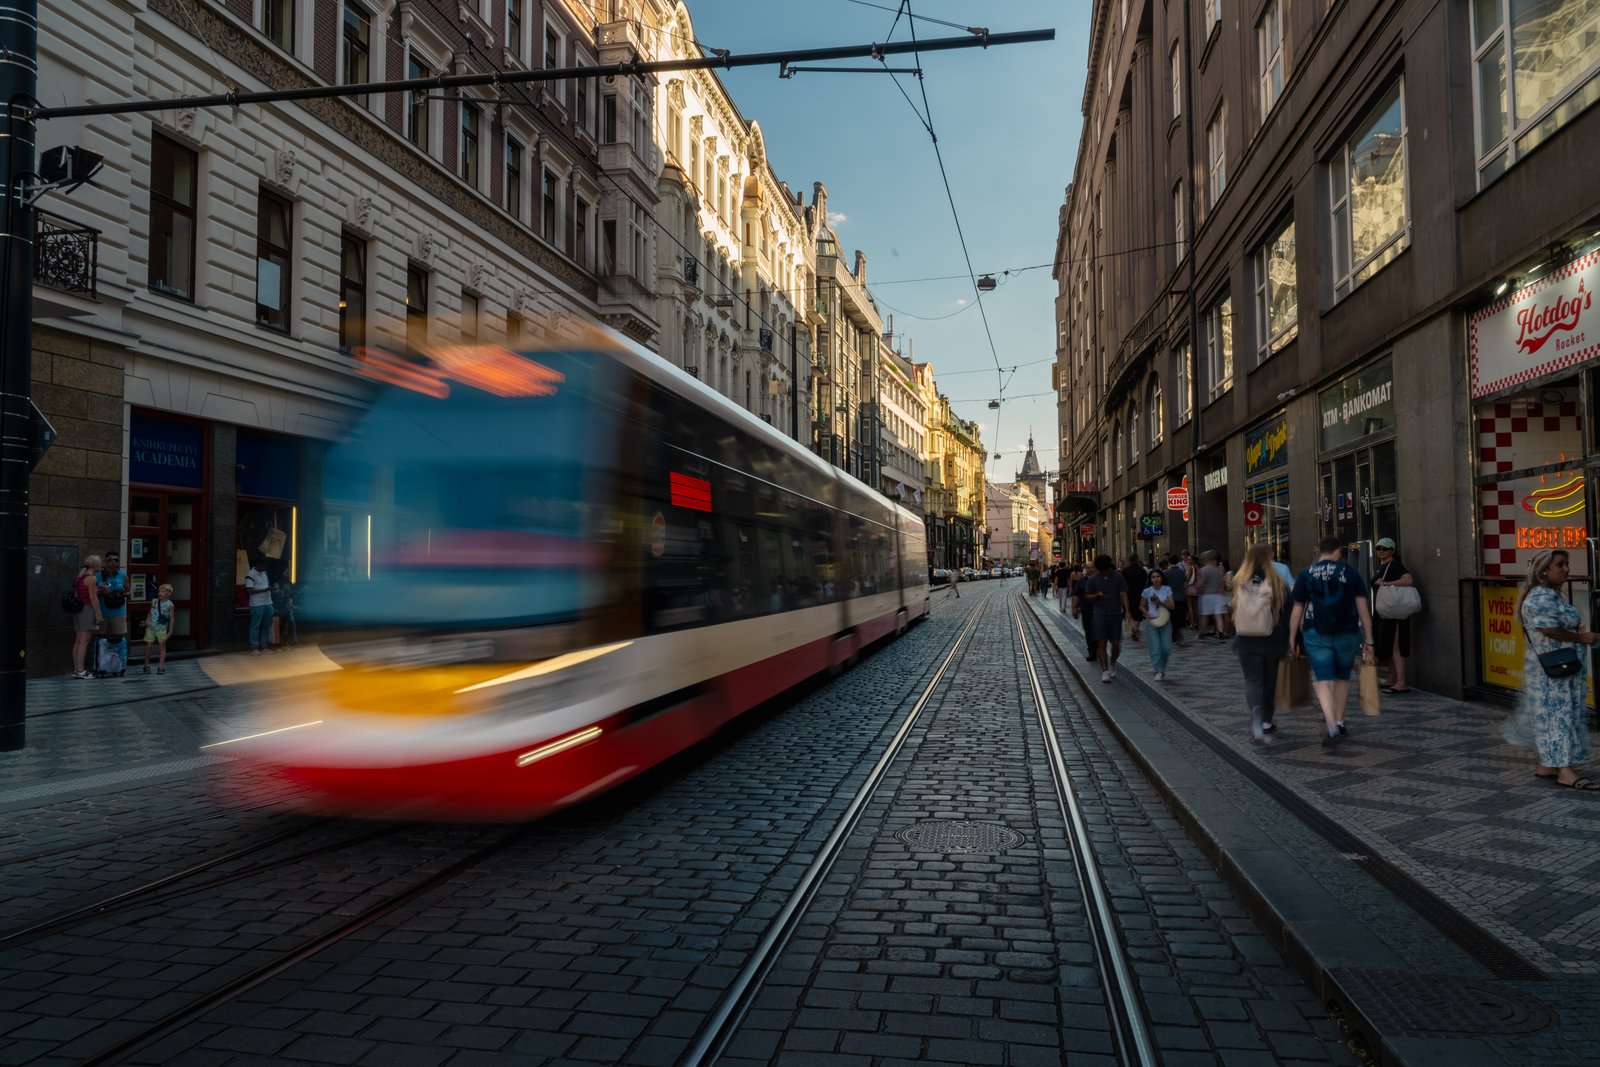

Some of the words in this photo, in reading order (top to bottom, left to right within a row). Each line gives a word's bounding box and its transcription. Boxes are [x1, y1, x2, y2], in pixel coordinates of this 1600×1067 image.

[1515, 290, 1592, 351] Hotdog's
[1555, 332, 1586, 351] Rocket
[1323, 407, 1338, 429] ATM
[1342, 381, 1392, 421] BANKOMAT
[134, 450, 196, 469] ACADEMIA
[1517, 526, 1560, 549] HOT
[1489, 618, 1512, 635] HLAD
[1488, 637, 1493, 652] I
[1490, 665, 1508, 676] CLASSIC
